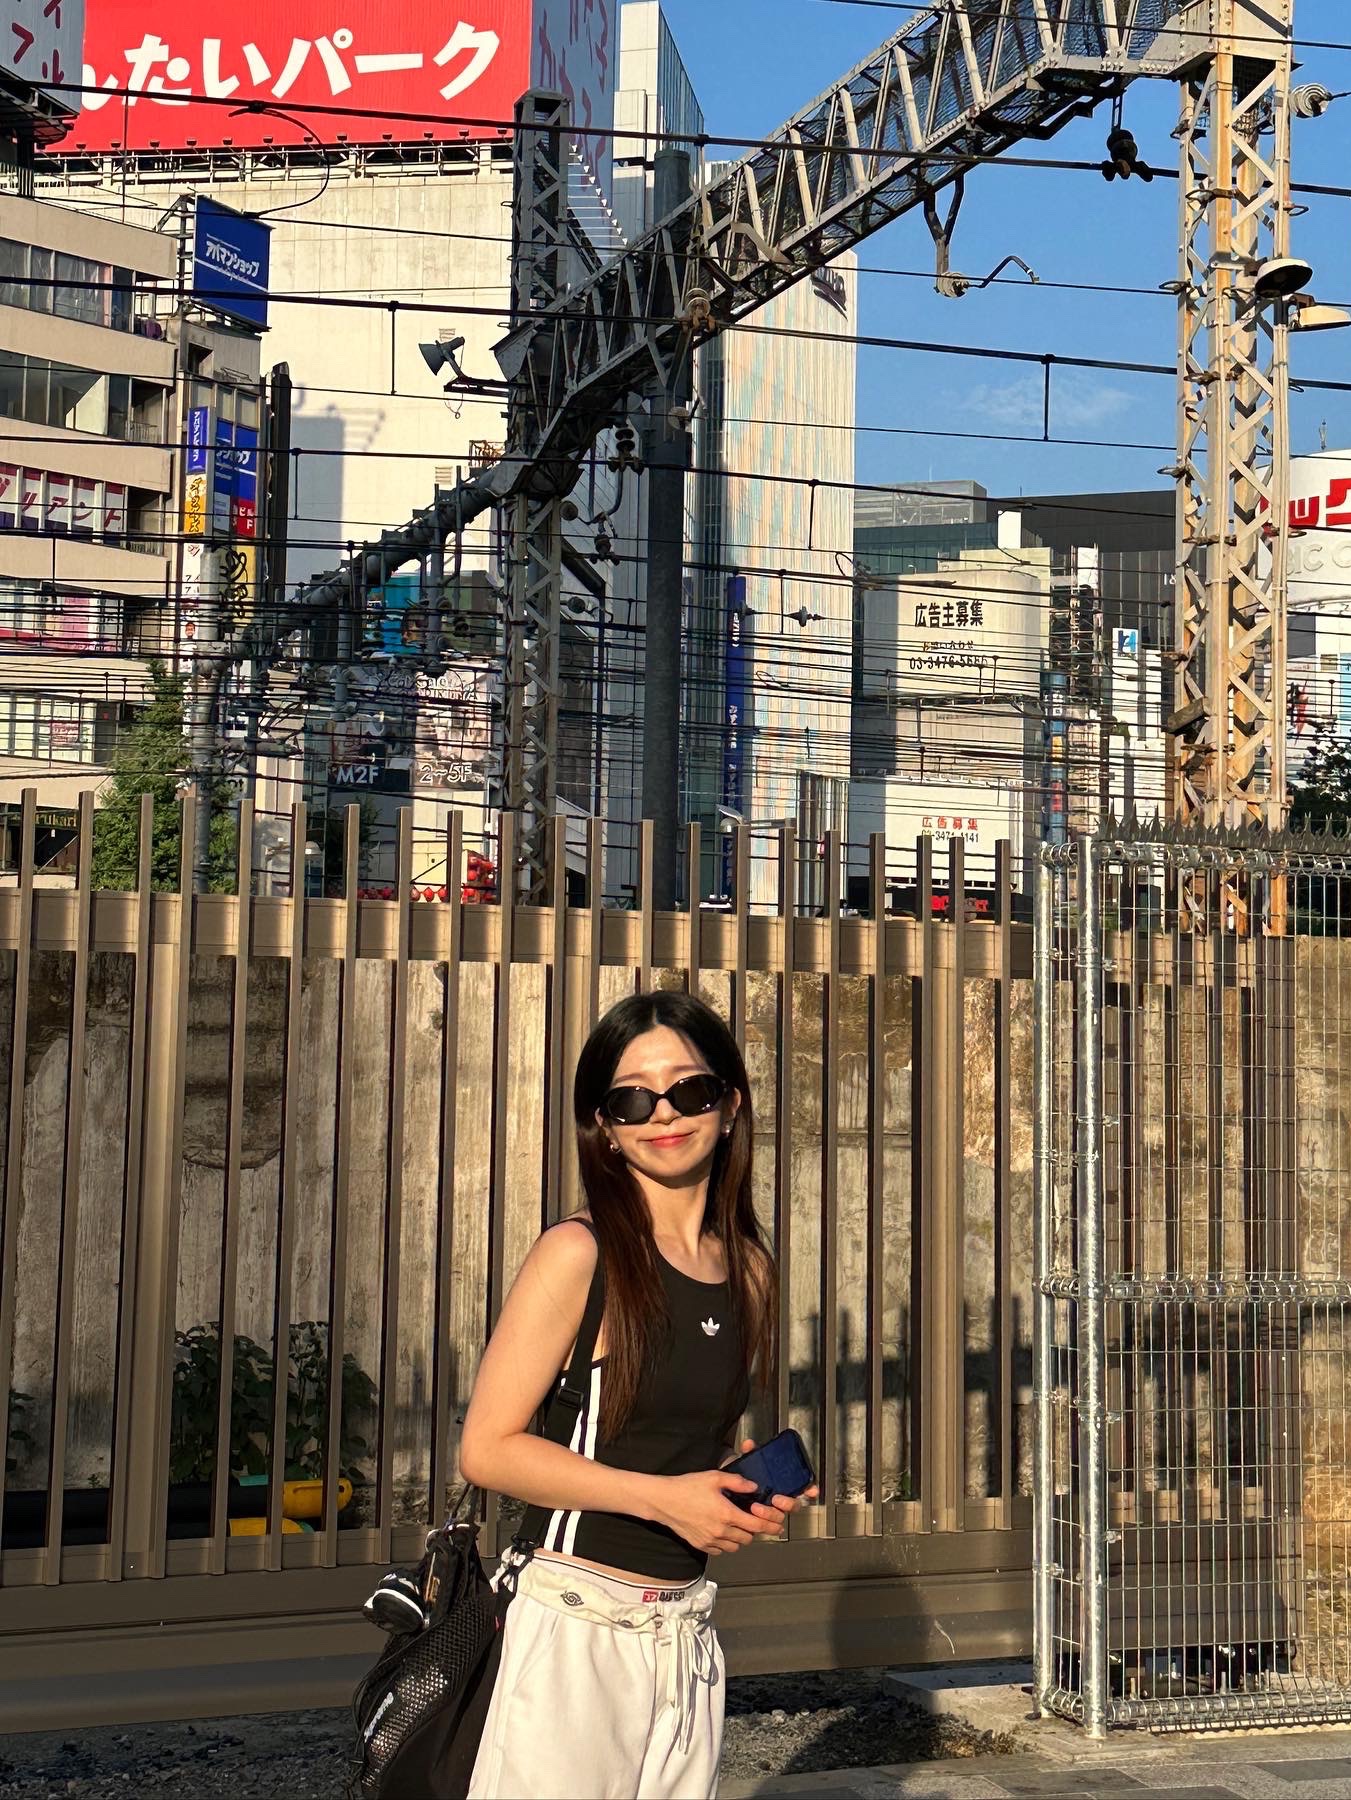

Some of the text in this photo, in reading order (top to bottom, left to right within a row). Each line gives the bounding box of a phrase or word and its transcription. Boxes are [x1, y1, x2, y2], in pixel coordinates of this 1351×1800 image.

[205, 240, 260, 278] アパマンショップ
[915, 600, 983, 628] 広告主募集
